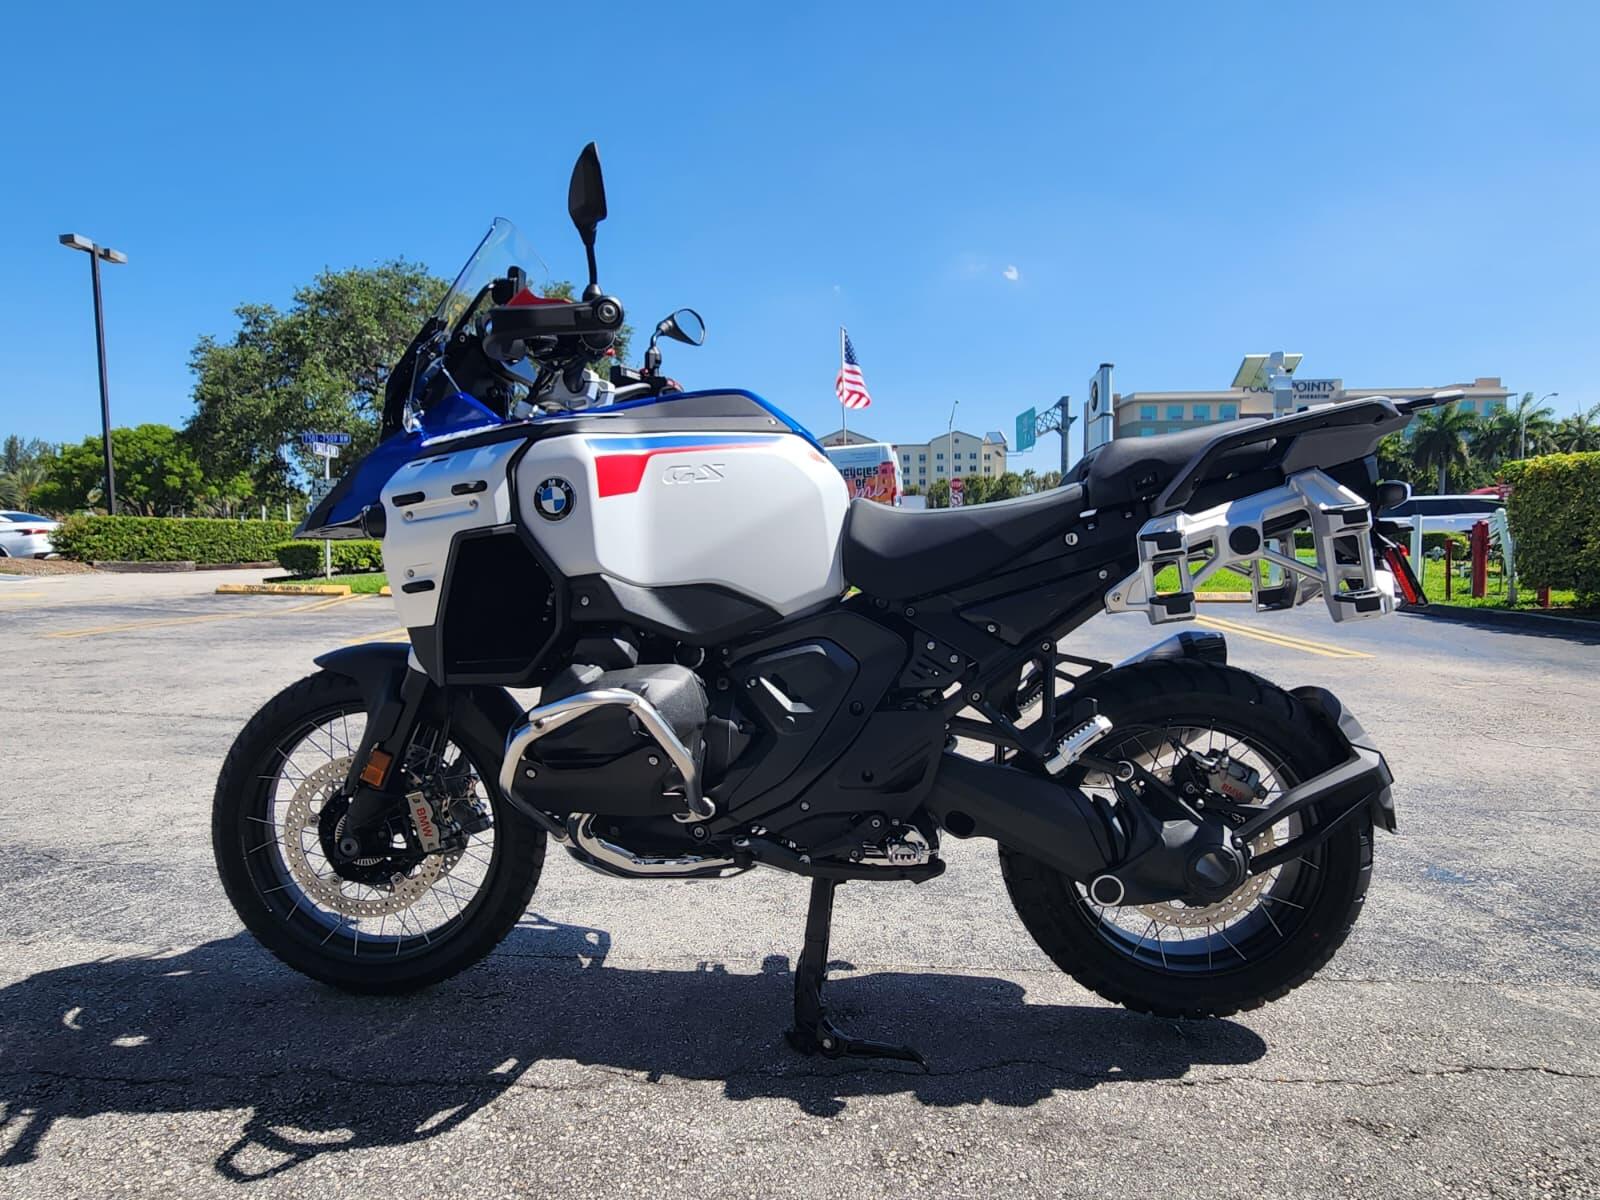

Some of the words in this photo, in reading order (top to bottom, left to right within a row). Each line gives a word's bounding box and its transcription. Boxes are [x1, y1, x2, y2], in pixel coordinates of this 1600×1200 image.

[536, 479, 570, 495] BMW
[1222, 784, 1243, 799] BMW
[417, 808, 432, 837] BMW
